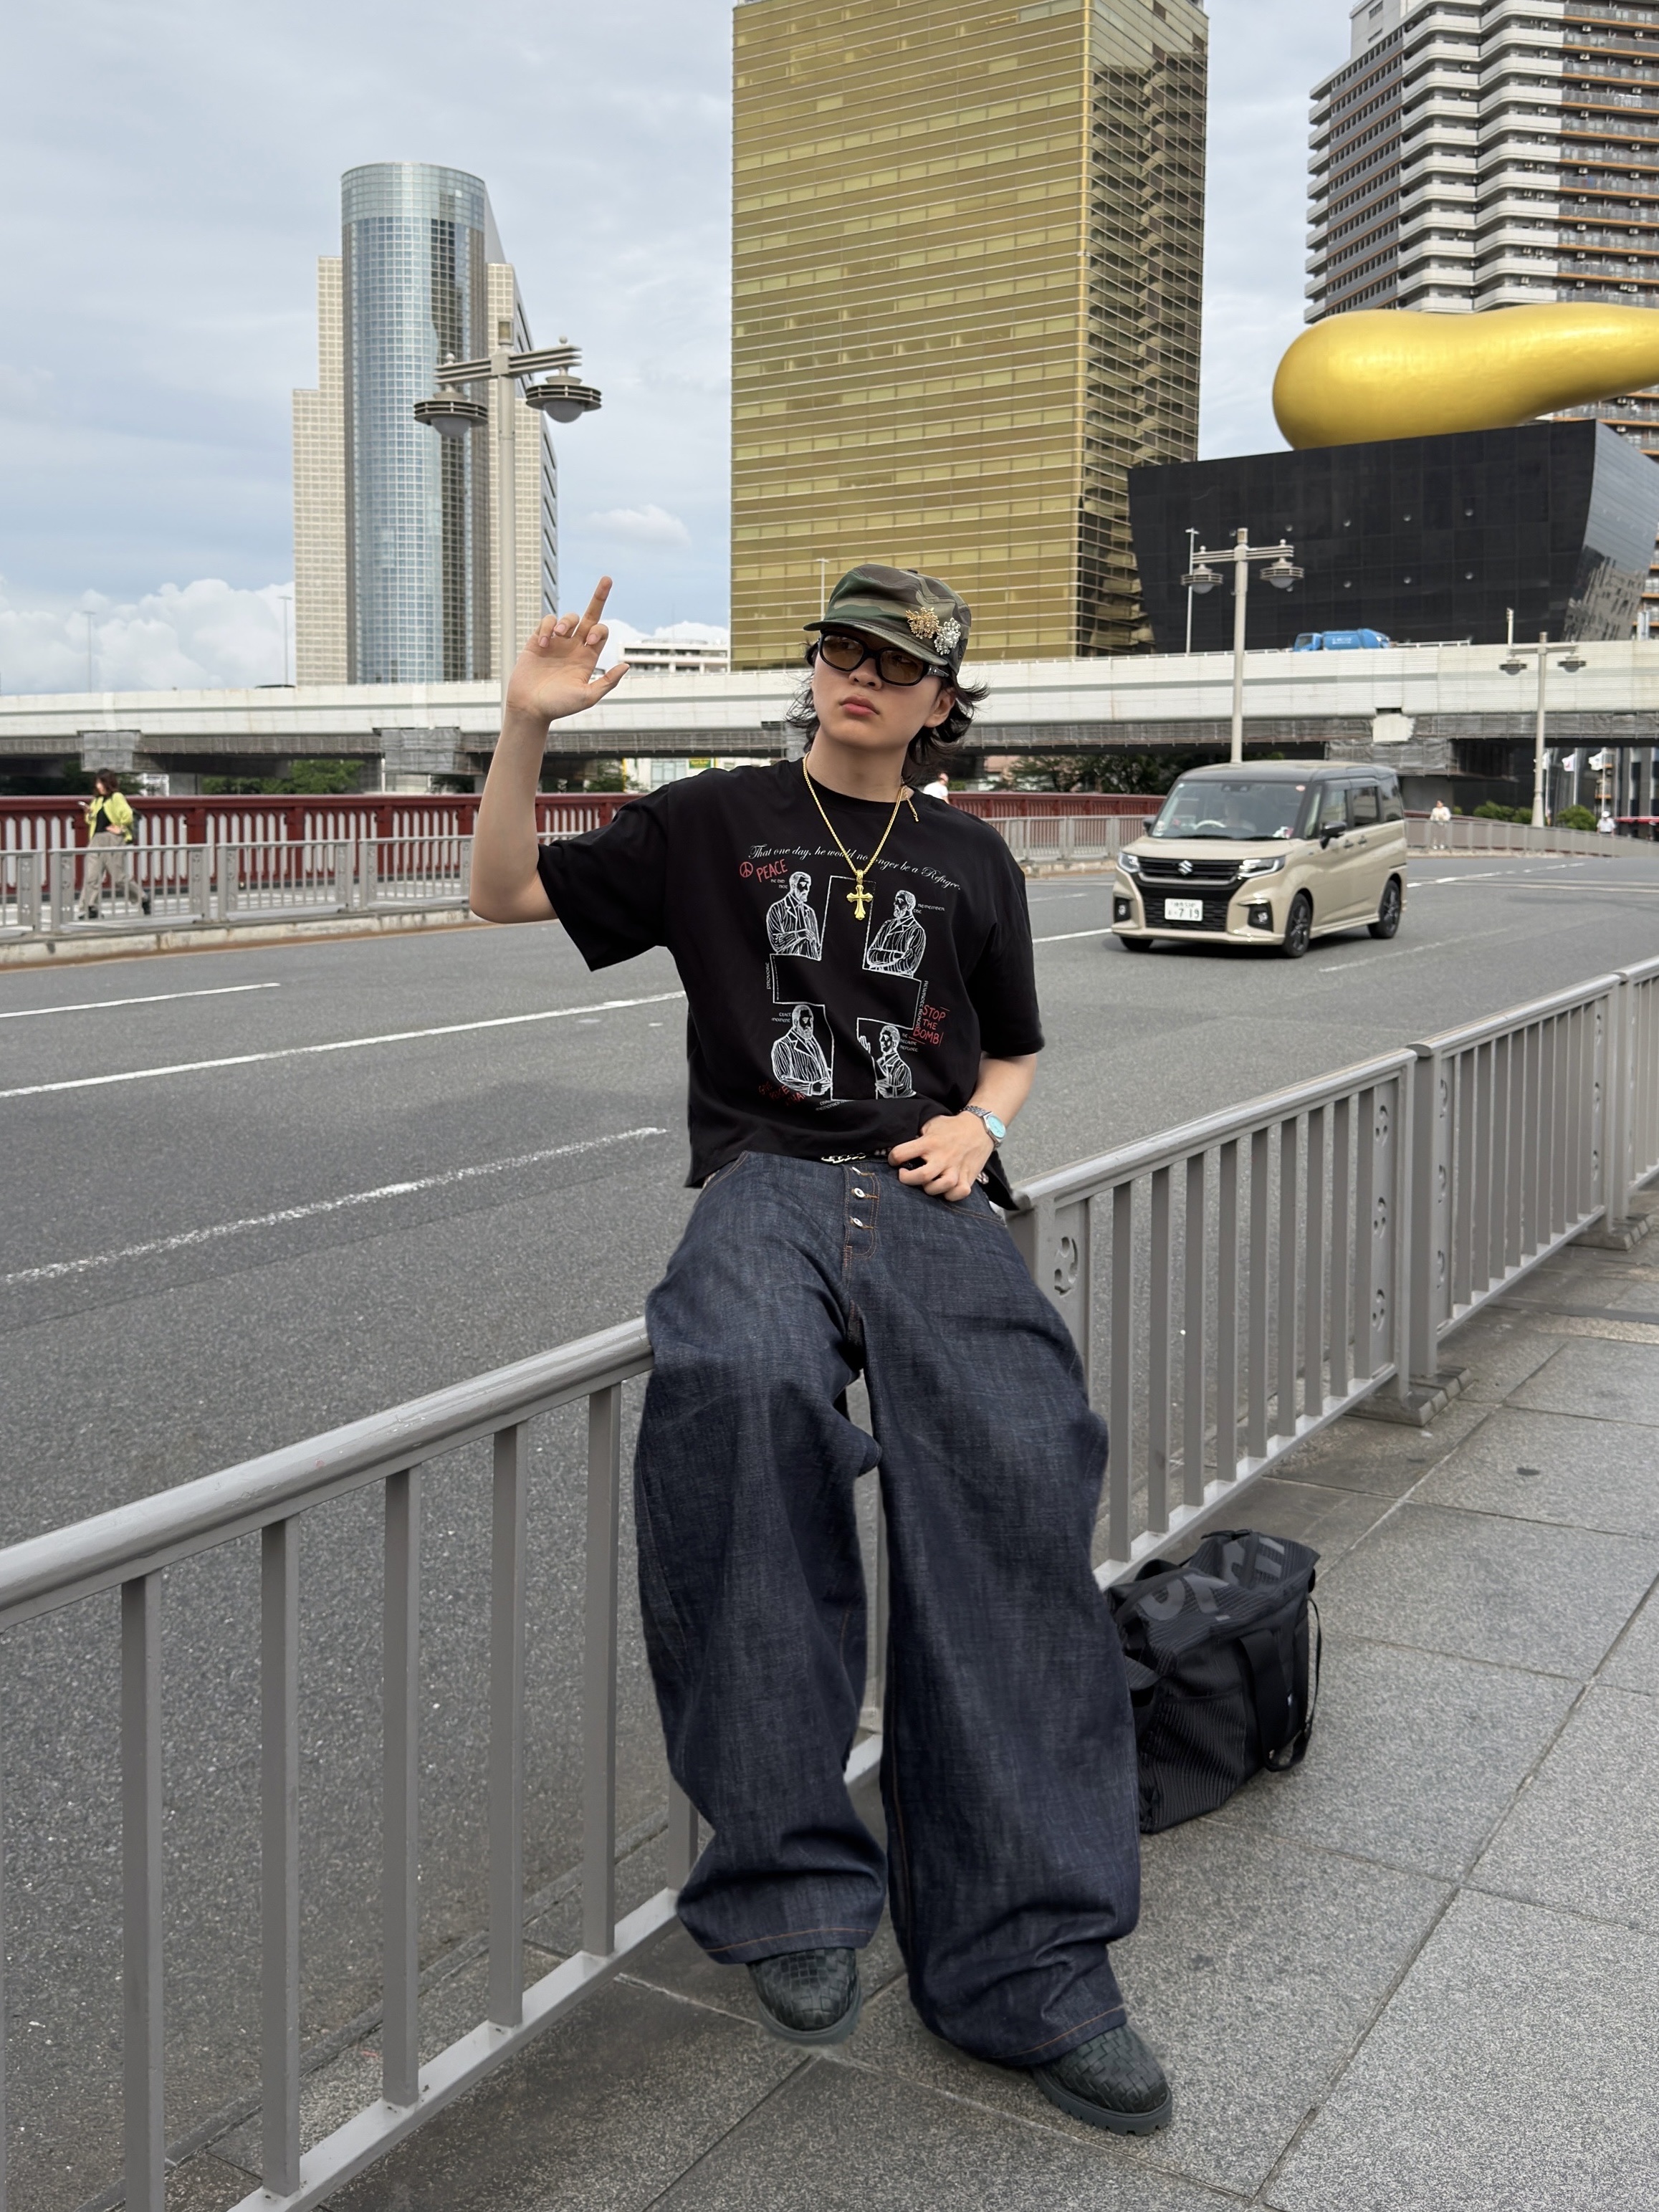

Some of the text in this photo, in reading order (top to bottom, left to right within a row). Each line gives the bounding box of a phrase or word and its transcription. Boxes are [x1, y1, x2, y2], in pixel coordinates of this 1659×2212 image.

[748, 844, 772, 859] That
[814, 846, 826, 856] he
[899, 861, 912, 872] be
[756, 859, 788, 883] PEACE
[922, 1005, 946, 1021] STOP
[922, 1018, 937, 1030] THE
